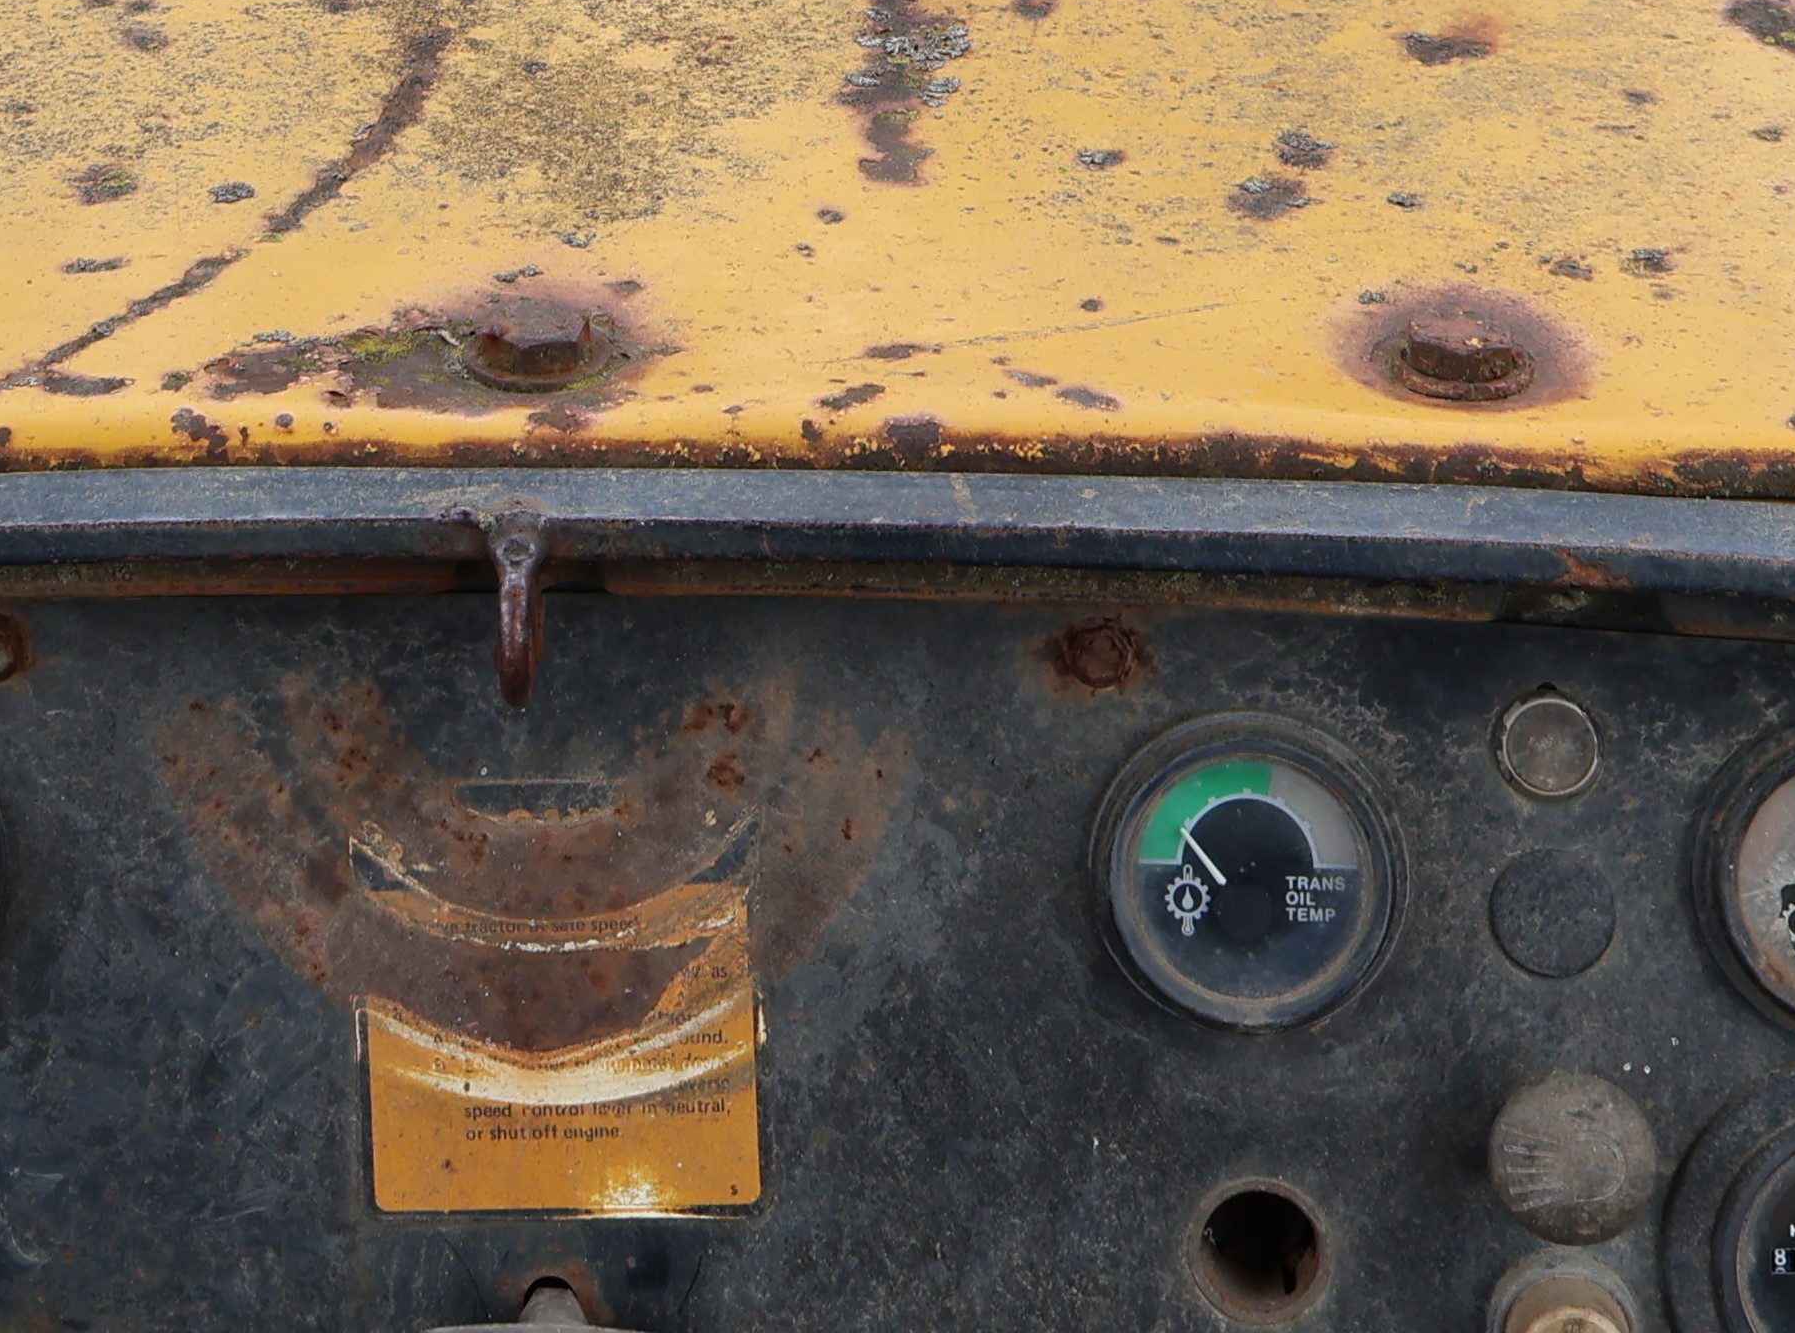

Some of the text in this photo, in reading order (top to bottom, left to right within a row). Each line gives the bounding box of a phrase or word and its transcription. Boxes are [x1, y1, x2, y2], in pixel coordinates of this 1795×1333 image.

[1285, 876, 1346, 891] TRANS
[1285, 891, 1316, 906] OIL
[1285, 907, 1336, 922] TEMP
[465, 1102, 513, 1121] speed
[466, 1129, 484, 1141] or
[490, 1124, 526, 1141] shut
[532, 1124, 557, 1140] off
